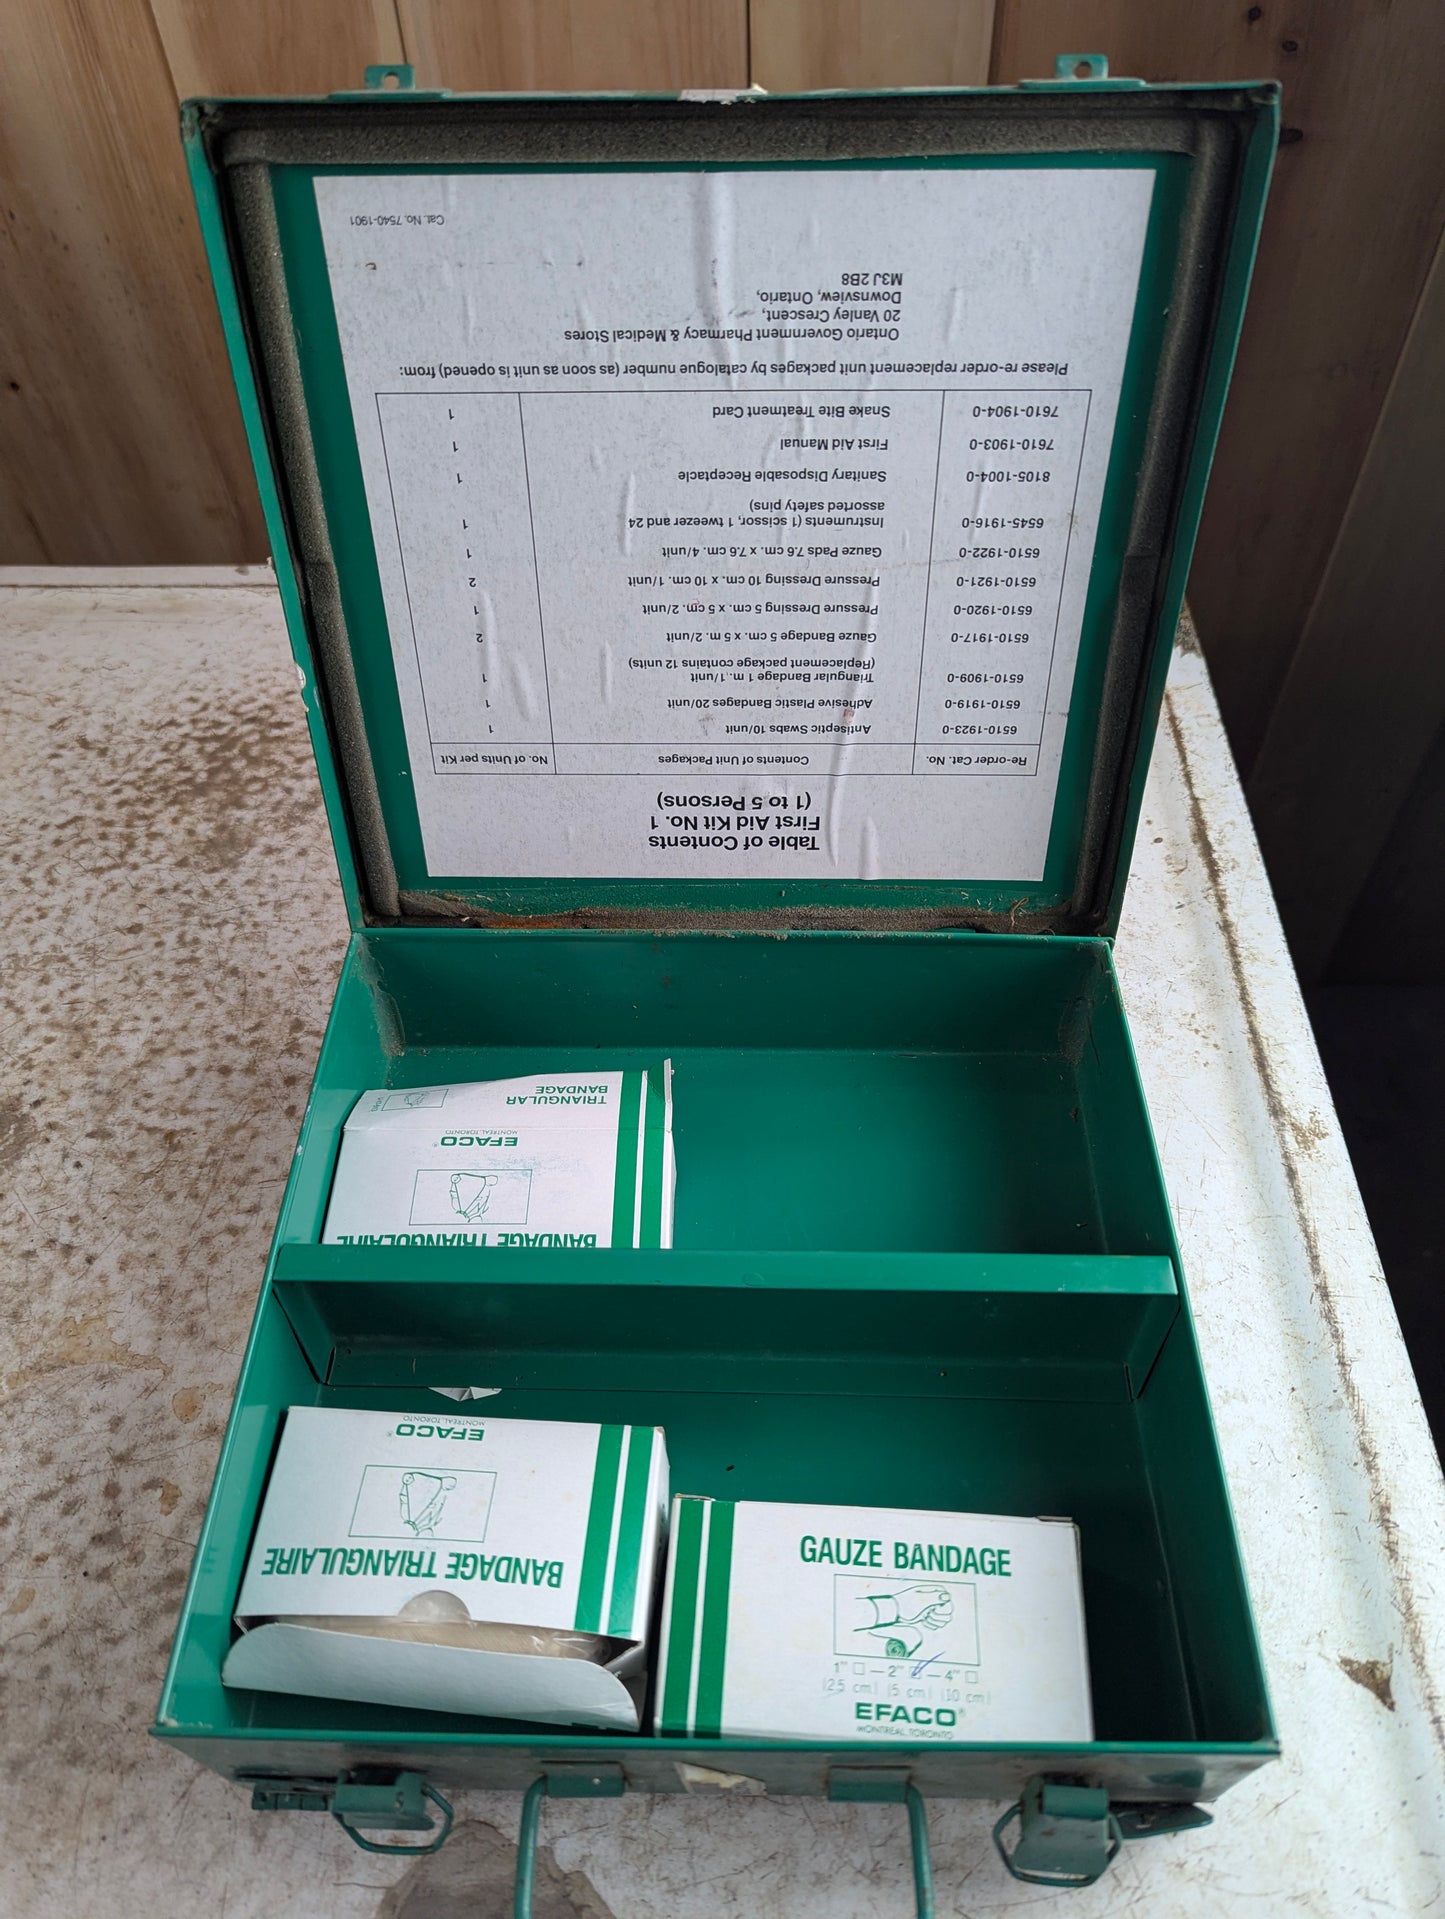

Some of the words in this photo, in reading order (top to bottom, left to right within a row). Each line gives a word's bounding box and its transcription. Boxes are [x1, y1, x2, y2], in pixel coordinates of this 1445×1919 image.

[350, 215, 403, 226] 7540-1901
[404, 215, 422, 225] No.
[424, 215, 445, 226] Cat.
[841, 272, 870, 287] 2B8
[872, 272, 904, 287] M3J
[756, 289, 814, 306] Ontario,
[817, 288, 902, 305] Downsview,
[761, 307, 830, 324] Crescent,
[832, 306, 880, 323] Vanley
[882, 309, 902, 323] 20
[563, 329, 610, 344] Stores
[612, 329, 667, 344] Medical
[669, 328, 680, 342] &
[683, 325, 753, 342] Pharmacy
[755, 327, 844, 342] Government
[846, 327, 900, 342] Ontario
[399, 366, 437, 380] from:
[438, 362, 496, 379] opened)
[497, 365, 511, 379] is
[512, 365, 541, 379] unit
[542, 364, 559, 376] as
[561, 364, 597, 375] soon
[598, 361, 620, 378] (as
[622, 364, 677, 378] number
[679, 360, 748, 377] catalogue
[750, 360, 767, 377] by
[769, 359, 837, 376] packages
[839, 363, 867, 376] unit
[869, 359, 958, 376] replacement
[959, 362, 1019, 376] re-order
[1020, 362, 1069, 376] Please
[712, 406, 745, 419] Card
[746, 405, 816, 419] Treatment
[817, 405, 846, 418] Bite
[848, 405, 891, 419] Snake
[972, 405, 1059, 418] 7610-1904-0
[780, 438, 829, 451] Manual
[831, 438, 856, 451] Aid
[857, 438, 889, 451] First
[968, 438, 1055, 451] 7610-1903-0
[677, 467, 752, 484] Receptacle
[754, 467, 829, 483] Disposable
[831, 467, 888, 483] Sanitary
[965, 470, 1051, 483] 8105-1004-0
[749, 498, 782, 513] pins)
[784, 498, 825, 513] safety
[827, 501, 886, 513] assorted
[628, 517, 644, 529] 24
[646, 517, 671, 529] and
[672, 516, 725, 528] tweezer
[728, 517, 734, 528] 1
[737, 515, 788, 529] scissor,
[792, 513, 803, 529] (1
[804, 516, 884, 529] Instruments
[961, 517, 1045, 529] 6545-1916-0
[661, 546, 700, 559] 4/unit
[703, 546, 727, 556] cm.
[729, 546, 748, 558] 7.6
[749, 546, 758, 556] x
[760, 546, 785, 556] cm.
[786, 546, 805, 558] 7.6
[807, 546, 839, 558] Pads
[841, 546, 883, 559] Gauze
[958, 546, 1041, 559] 6510-1922-0
[468, 577, 477, 588] 2
[627, 575, 665, 588] 1/unit
[668, 575, 692, 585] cm.
[694, 575, 708, 587] 10
[711, 575, 719, 585] x
[721, 575, 746, 585] cm.
[747, 575, 762, 587] 10
[765, 572, 822, 587] Dressing
[824, 575, 881, 587] Pressure
[956, 576, 1037, 588] 6510-1921-0
[641, 604, 680, 616] 2/unit
[682, 603, 705, 612] cm.
[707, 604, 716, 615] 5
[718, 604, 726, 613] x
[728, 604, 752, 613] cm.
[754, 603, 763, 615] 5
[765, 601, 821, 615] Dressing
[823, 604, 879, 616] Pressure
[953, 604, 1033, 616] 6510-1920-0
[475, 632, 484, 644] 2
[665, 632, 703, 643] 2/unit
[705, 632, 722, 641] m.
[723, 632, 732, 643] 5
[734, 632, 742, 641] x
[744, 632, 768, 641] cm.
[770, 631, 778, 643] 5
[779, 629, 836, 643] Bandage
[838, 632, 877, 643] Gauze
[950, 632, 1030, 644] 6510-1917-0
[628, 656, 663, 670] units)
[665, 659, 679, 670] 12
[681, 659, 734, 670] contains
[736, 656, 788, 670] package
[789, 656, 876, 670] (Replacement
[748, 672, 754, 683] 1
[756, 670, 812, 683] Bandage
[813, 670, 875, 684] Triangular
[946, 673, 1024, 684] 6510-1909-0
[666, 698, 710, 710] 20/unit
[712, 696, 772, 710] Bandages
[774, 698, 815, 709] Plastic
[817, 698, 874, 711] Adhesive
[944, 699, 1021, 710] 6510-1919-0
[725, 724, 767, 735] 10/unit
[768, 724, 809, 735] Swabs
[810, 722, 872, 736] Antiseptic
[941, 724, 1018, 736] 6510-1923-0
[440, 755, 458, 765] Kit
[459, 752, 479, 763] per
[480, 754, 513, 765] Units
[514, 755, 527, 765] of
[528, 755, 549, 765] No.
[657, 753, 713, 766] Packages
[715, 755, 740, 766] Unit
[741, 755, 755, 766] of
[756, 755, 810, 766] Contents
[925, 755, 946, 766] No.
[948, 755, 973, 766] Cat.
[973, 756, 1028, 767] Re-order
[656, 791, 746, 812] Persons)
[751, 796, 764, 811] 5
[768, 796, 789, 810] to
[796, 791, 812, 811] (1
[650, 815, 660, 831] 1
[665, 815, 698, 831] No.
[703, 815, 731, 831] Kit
[736, 815, 771, 831] Aid
[774, 815, 821, 831] First
[647, 835, 739, 851] Contents
[742, 835, 764, 851] of
[768, 835, 821, 851] Table
[535, 1085, 609, 1094] BANDAGE
[505, 1096, 607, 1105] TRIANGULAR
[261, 1547, 438, 1578] TRIANGULAIRE
[800, 1535, 883, 1568] GAUZE
[894, 1541, 1012, 1577] BANDAGE
[445, 1551, 565, 1589] BANDAGE
